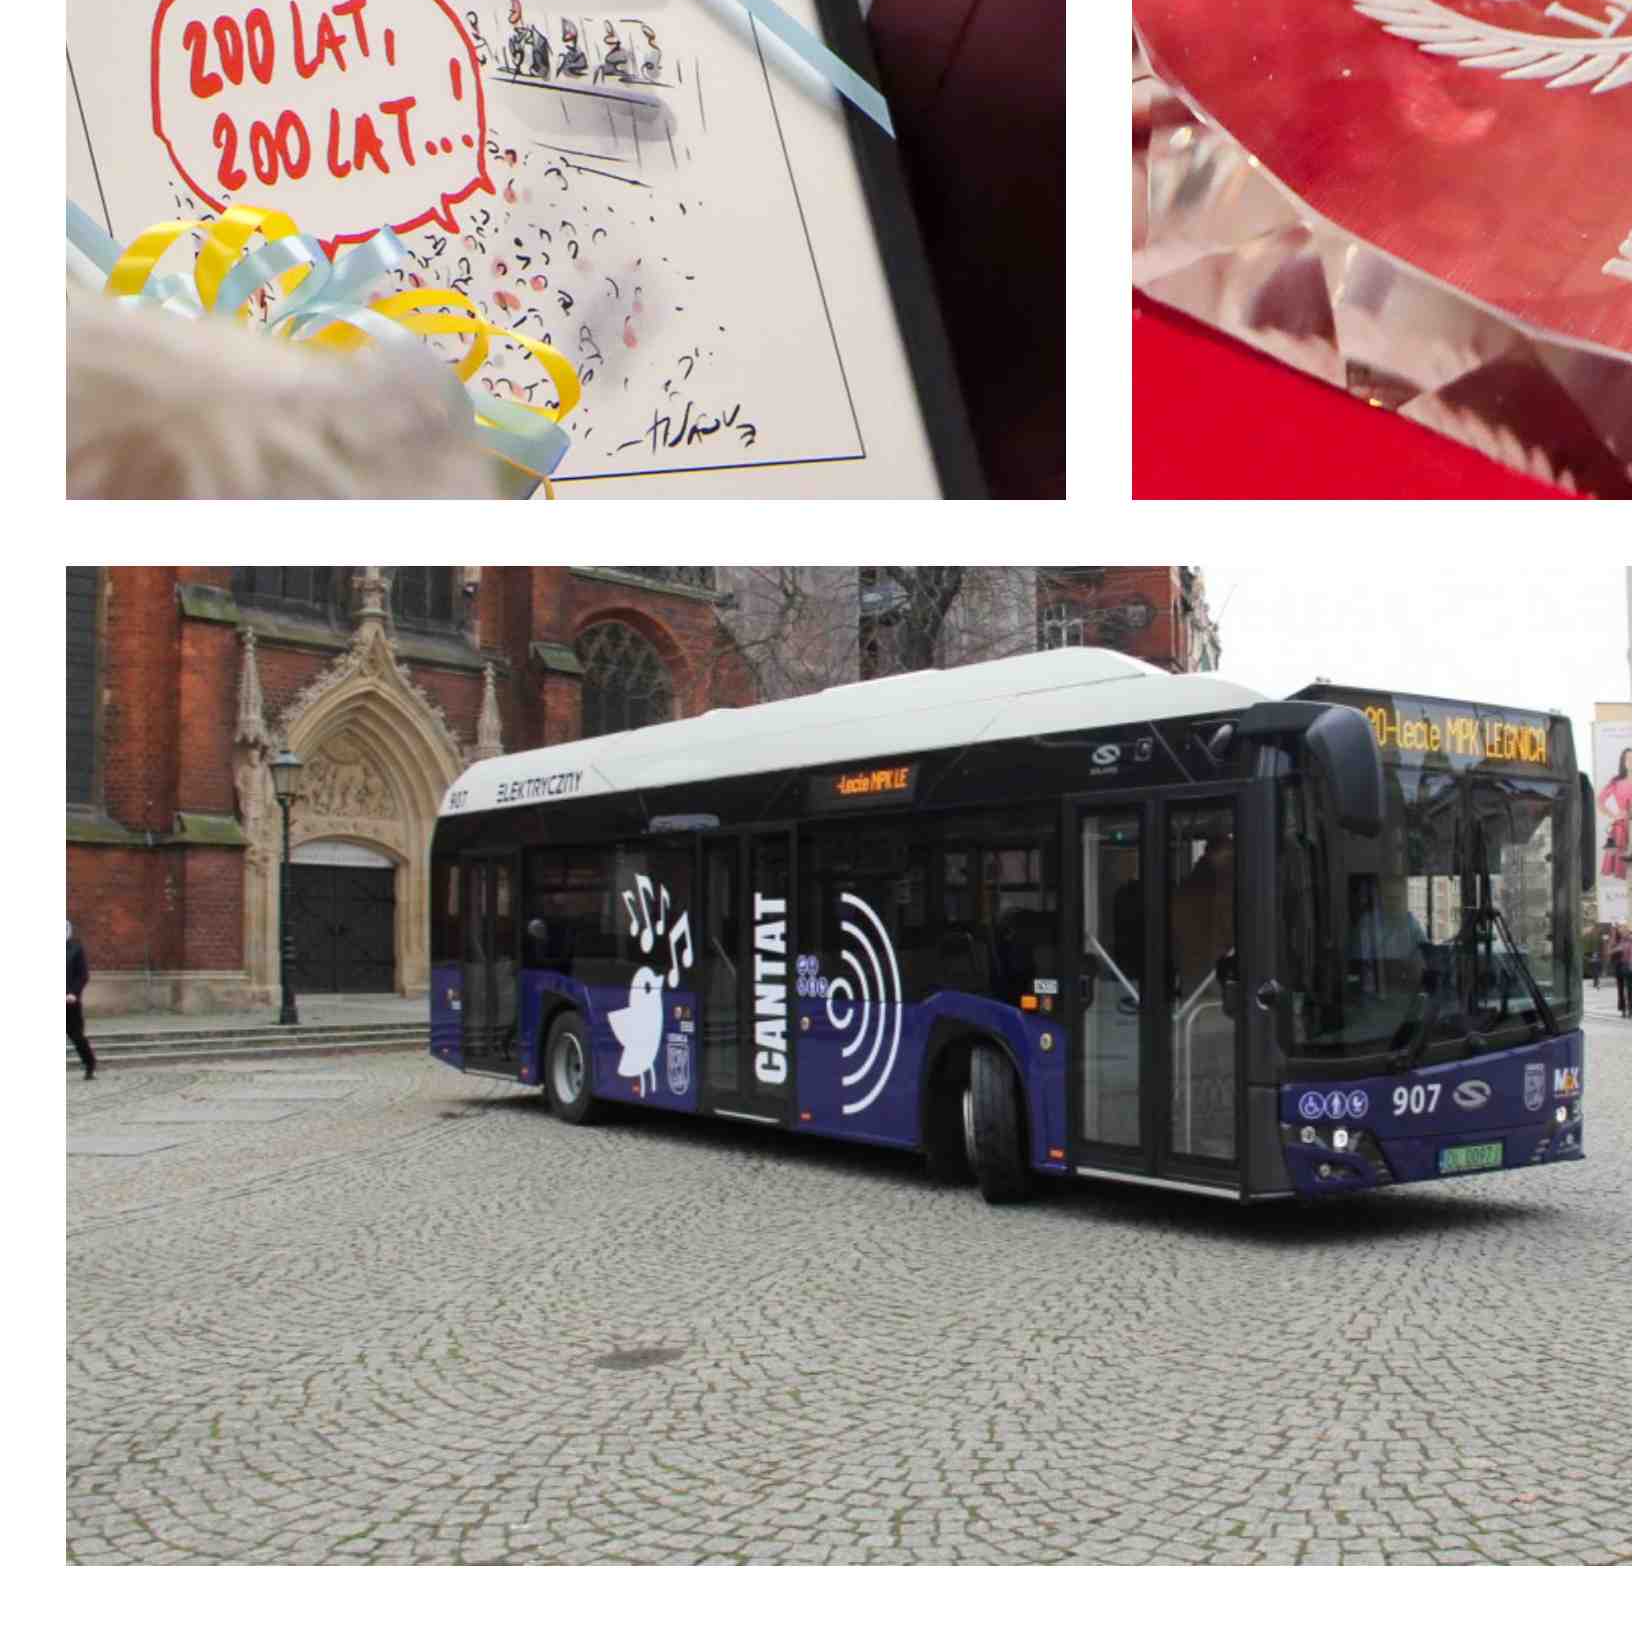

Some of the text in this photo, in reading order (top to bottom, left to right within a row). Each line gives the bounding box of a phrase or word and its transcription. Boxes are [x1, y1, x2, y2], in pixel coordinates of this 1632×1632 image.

[183, 8, 274, 99] 200
[212, 109, 311, 192] 200
[1445, 716, 1481, 757] MPK
[1486, 720, 1548, 763] LEGNICA
[496, 769, 583, 804] ELEKTRYCZNY
[754, 892, 788, 1085] CANTAT
[1392, 1083, 1442, 1117] 907
